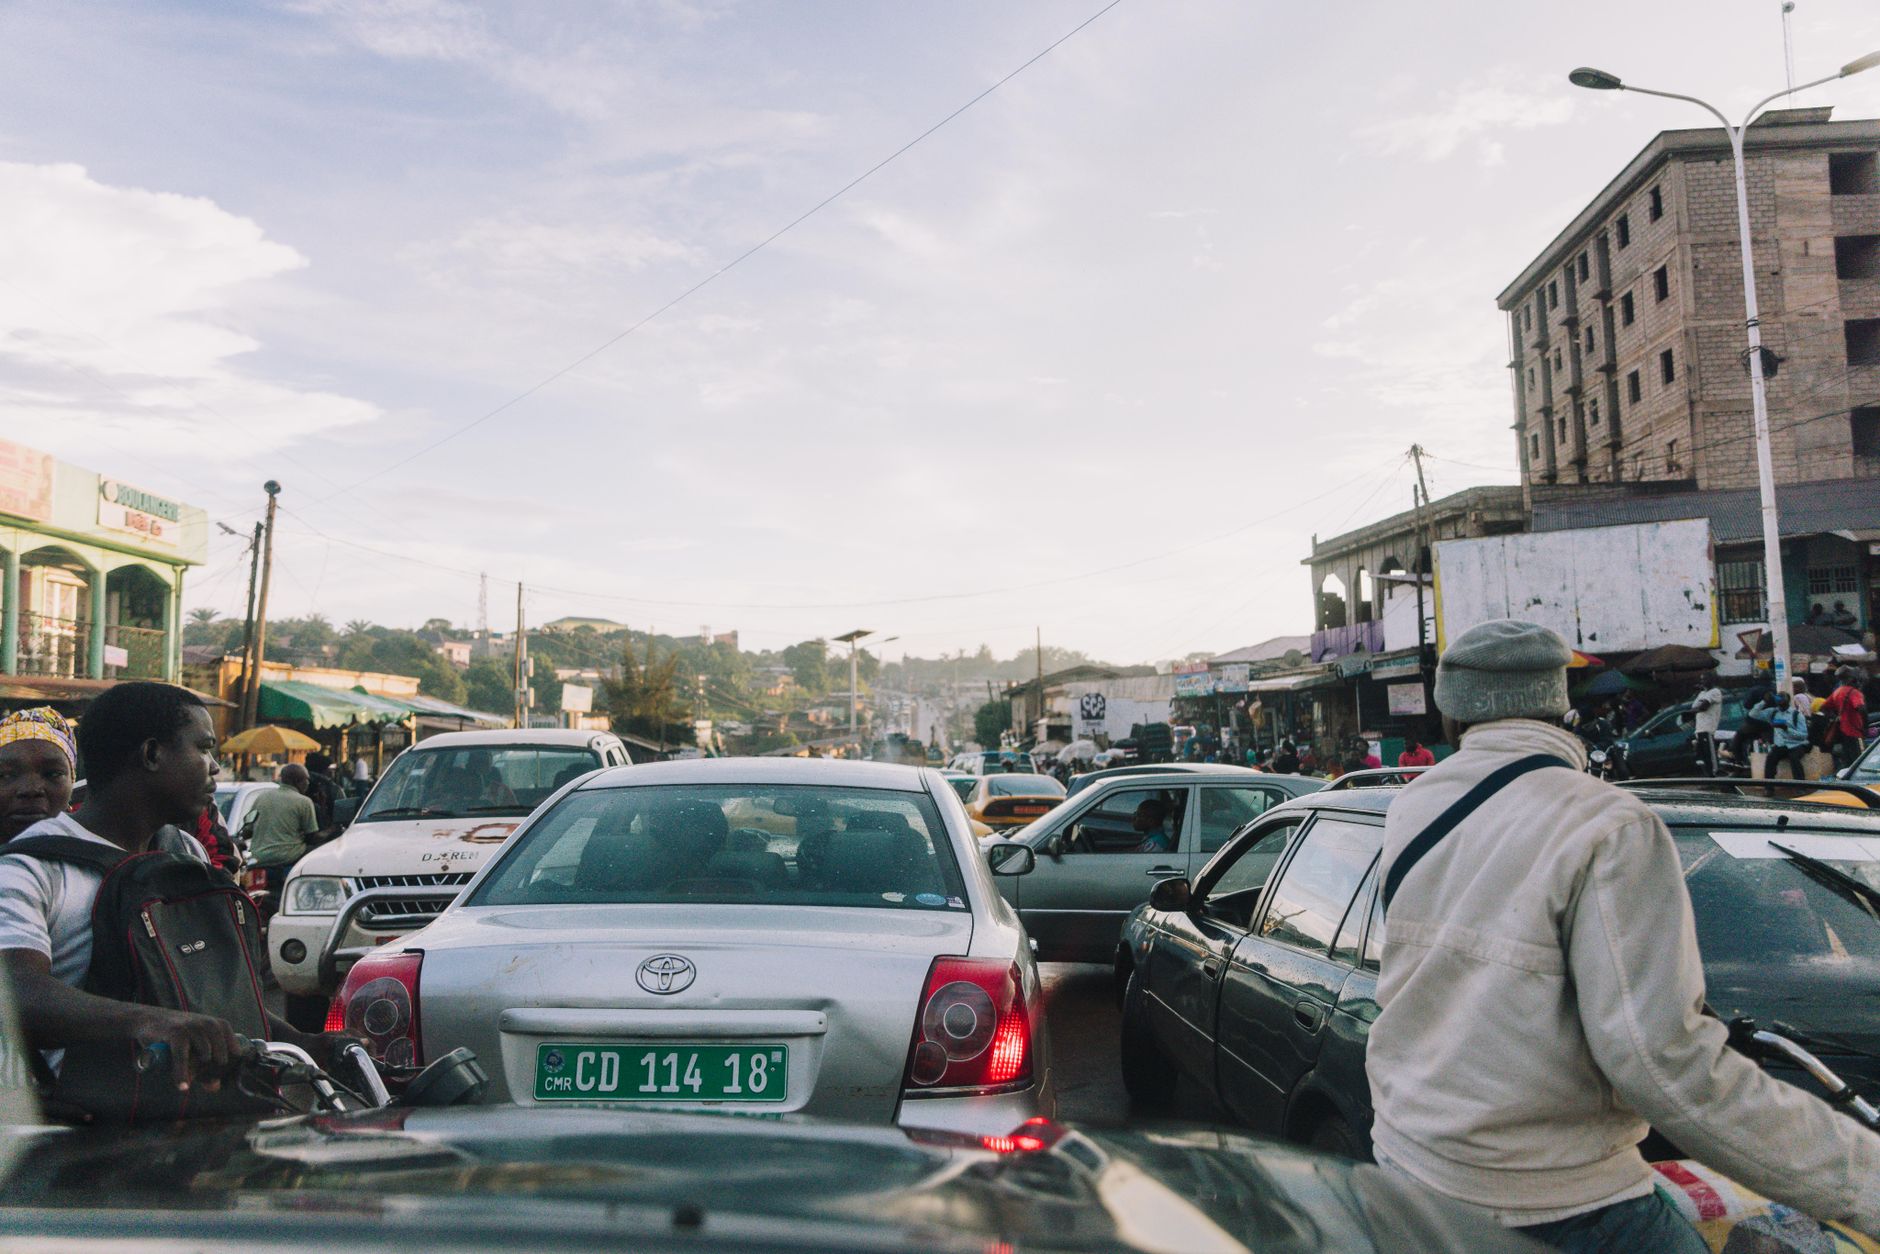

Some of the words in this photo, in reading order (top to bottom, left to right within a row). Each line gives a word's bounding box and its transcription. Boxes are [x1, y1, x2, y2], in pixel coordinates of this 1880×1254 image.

[116, 482, 179, 523] BOULANGERIE
[544, 1076, 572, 1092] CMR
[575, 1051, 621, 1092] CD
[638, 1052, 703, 1094] 114
[722, 1053, 768, 1094] 18
